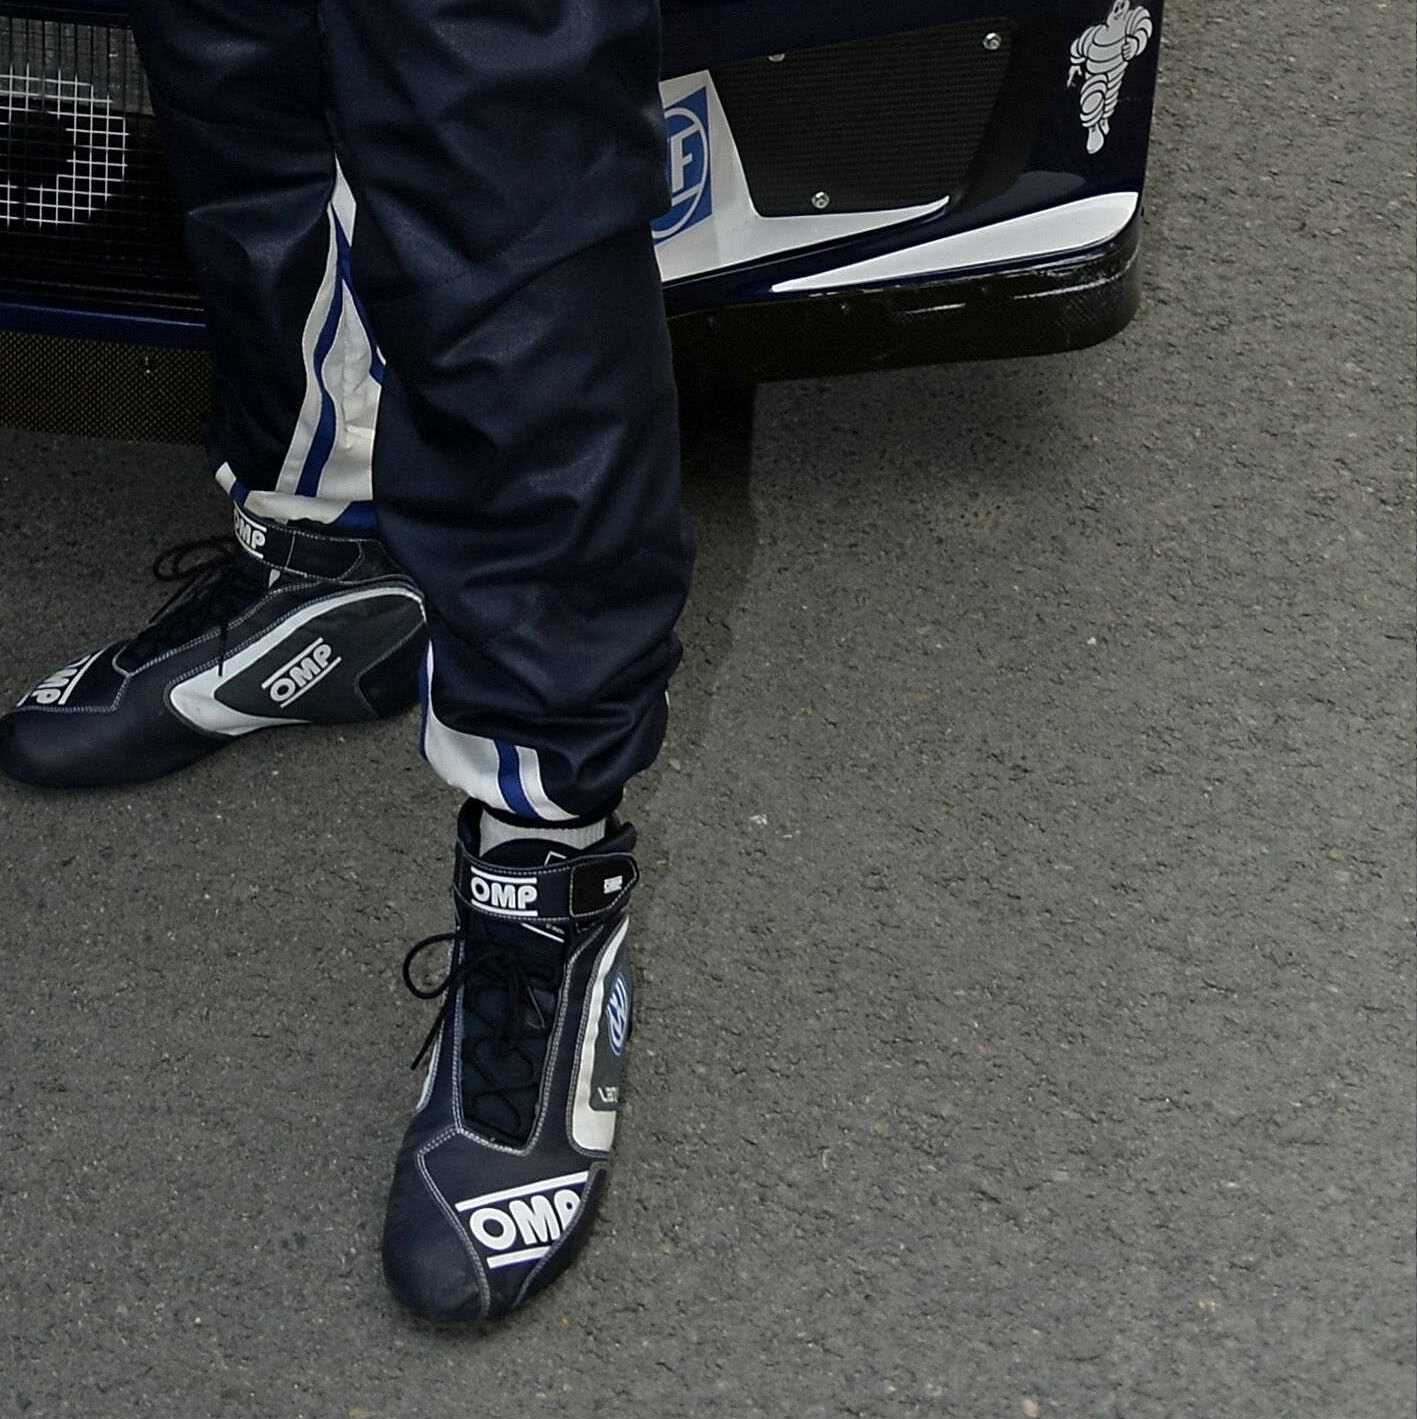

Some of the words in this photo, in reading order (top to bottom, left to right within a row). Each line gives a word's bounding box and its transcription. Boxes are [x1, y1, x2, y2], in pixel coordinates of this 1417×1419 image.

[269, 643, 332, 703] OMP
[470, 877, 538, 911] OMP
[469, 1189, 581, 1250] OMP
